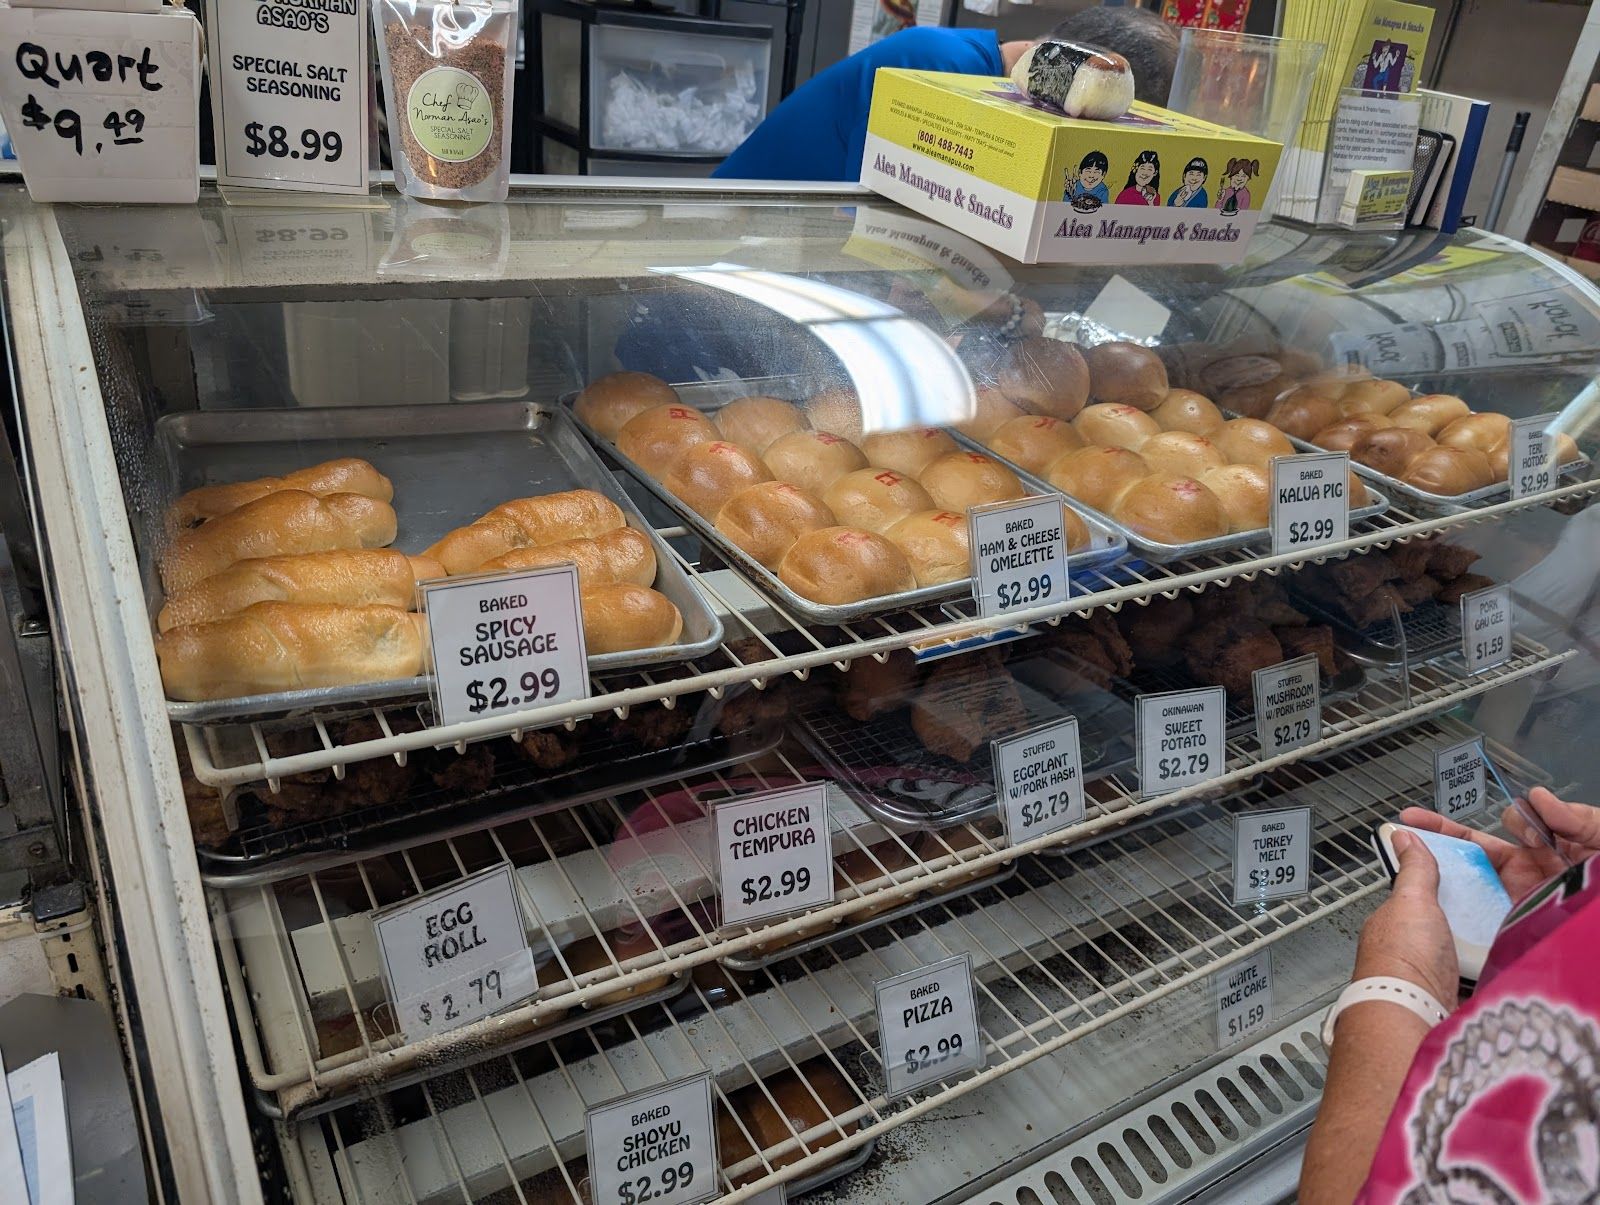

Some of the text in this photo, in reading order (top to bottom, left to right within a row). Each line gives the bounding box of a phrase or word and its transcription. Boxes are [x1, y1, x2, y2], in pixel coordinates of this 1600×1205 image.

[257, 4, 330, 33] ASAO'S
[16, 42, 163, 92] Quart
[232, 54, 348, 83] SPECIAL SALT
[246, 77, 341, 102] SEASONING
[422, 92, 452, 112] Chef
[412, 106, 455, 121] Norman
[244, 121, 343, 162] $8.99
[430, 125, 474, 135] SPECIAL SALT
[433, 132, 471, 141] SEASONING
[912, 143, 975, 172] www.aieamanapua.com
[917, 129, 937, 147] (808)
[937, 137, 974, 160] 488-7443
[873, 153, 1014, 230] Aiea Manapua & Snacks
[1054, 218, 1240, 245] Aiea Manapua & Snacks
[1522, 453, 1548, 469] HOTDOG
[1300, 470, 1323, 480] BAKED
[1521, 471, 1549, 494] $2.99
[1279, 482, 1343, 504] KALUA PIG
[1005, 518, 1034, 534] BAKED
[1289, 518, 1334, 544] $2.99
[980, 527, 1060, 557] HAM & CHEESE
[990, 545, 1055, 574] OMELETTE
[479, 594, 528, 613] BAKED
[997, 574, 1052, 610] $2.99
[1480, 597, 1498, 614] PORK
[475, 615, 537, 642] SPICY
[1475, 617, 1489, 631] GAU
[459, 632, 559, 667] SAUSAGE
[1476, 635, 1503, 660] $1.59
[466, 667, 560, 714] $2.99
[1277, 674, 1302, 689] STUFFED
[1265, 697, 1316, 720] W/PORK HASH
[1266, 683, 1314, 708] MUSHROOM
[1162, 702, 1204, 717] OKINAWAN
[1165, 719, 1203, 736] SWEET
[1274, 718, 1310, 747] $2.79
[1022, 739, 1056, 758] STUFFED
[1161, 733, 1207, 752] POTATO
[1013, 752, 1069, 784] EGGPLANT
[1158, 752, 1209, 780] $2.79
[1440, 757, 1482, 782] TERI CHEESE
[1009, 766, 1076, 800] W/PORK HASH
[1448, 771, 1475, 790] BURGER
[1021, 790, 1069, 828] $2.79
[1448, 787, 1478, 814] $2.99
[733, 806, 811, 837] CHICKEN
[1261, 822, 1286, 833] BAKED
[729, 827, 816, 860] TEMPURA
[1252, 834, 1294, 850] TURKEY
[1258, 848, 1287, 863] MELT
[741, 867, 811, 906] $2.99
[1249, 864, 1295, 889] $2.99
[425, 901, 474, 940] EGG
[424, 925, 488, 968] ROLL
[1229, 964, 1258, 989] WHITE
[910, 982, 940, 1000] BAKED
[1220, 976, 1268, 1010] RICE CAKE
[903, 995, 953, 1028] PIZZA
[1228, 1004, 1264, 1037] $1.59
[904, 1033, 963, 1075] $2.99
[631, 1105, 671, 1126] BAKED
[623, 1120, 681, 1153] SHOYU
[617, 1134, 690, 1172] CHICKEN
[617, 1161, 694, 1205] $2.99
